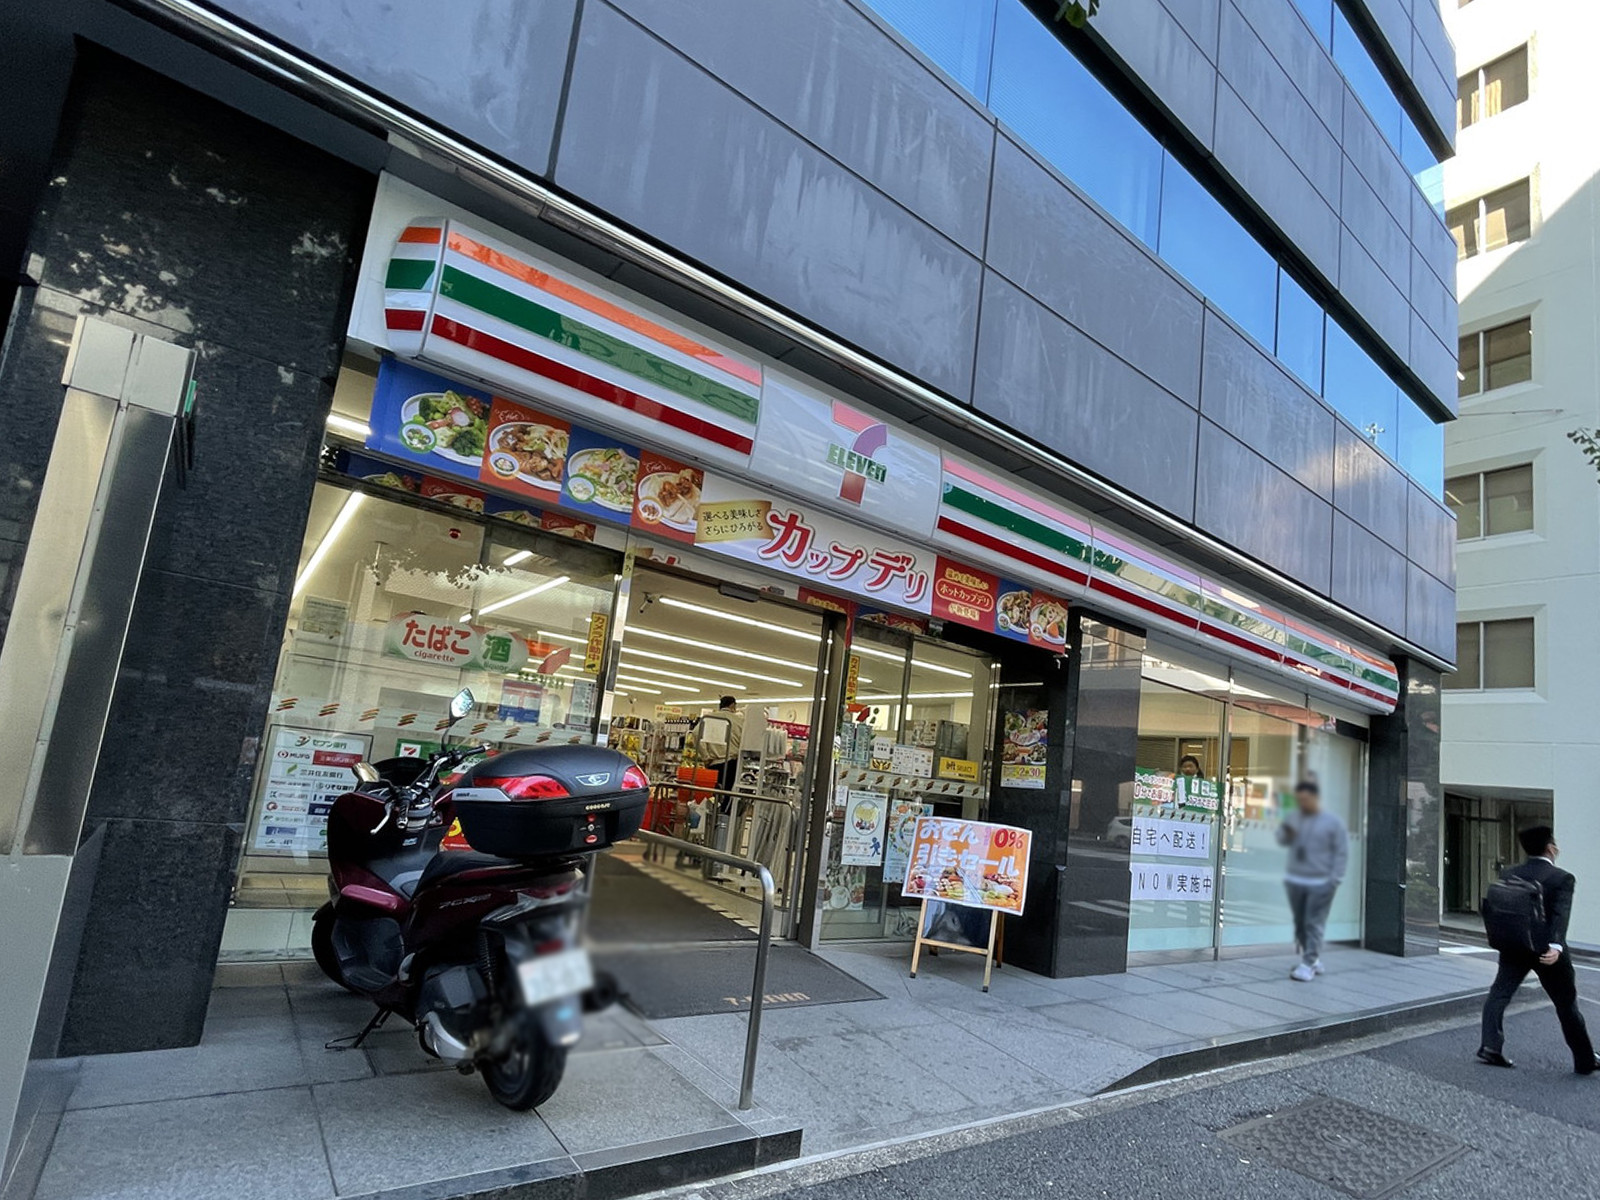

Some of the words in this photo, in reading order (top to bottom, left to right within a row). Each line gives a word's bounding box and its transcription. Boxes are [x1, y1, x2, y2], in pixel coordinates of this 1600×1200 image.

[702, 508, 762, 522] 選べる美味しさ
[705, 521, 764, 536] さらにひろがる
[759, 511, 927, 602] カップデリ
[939, 584, 990, 607] ホットカップデリ
[402, 619, 472, 656] たばこ
[483, 633, 513, 663] 酒
[414, 649, 456, 663] cigarette
[919, 820, 979, 845] おでん
[916, 843, 1020, 876] 引きセール
